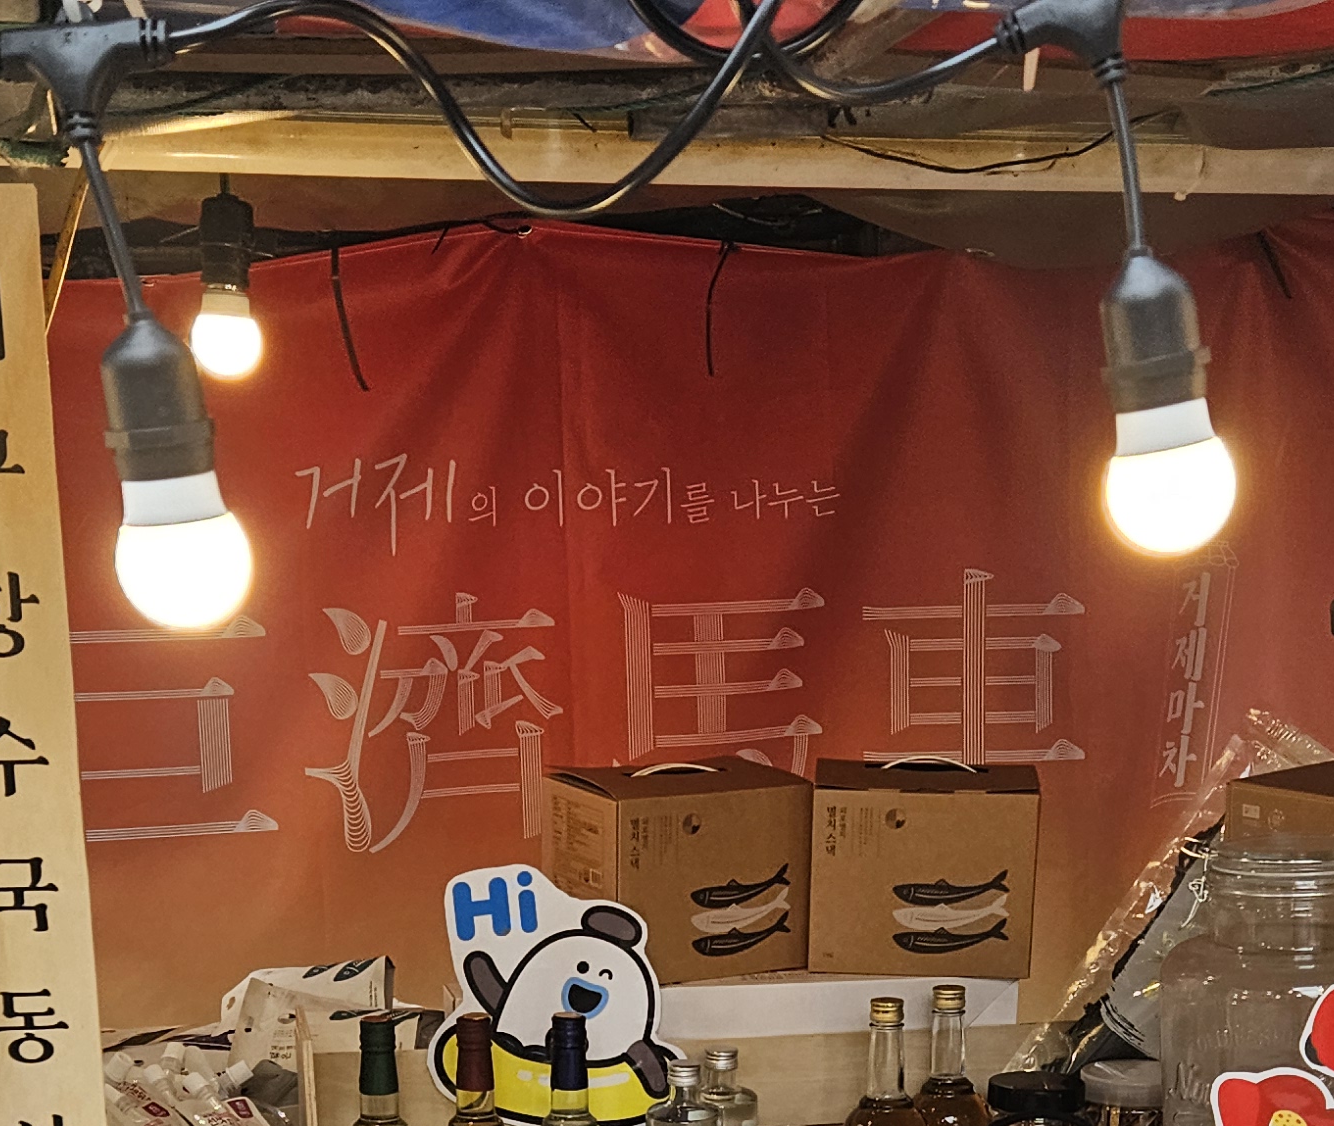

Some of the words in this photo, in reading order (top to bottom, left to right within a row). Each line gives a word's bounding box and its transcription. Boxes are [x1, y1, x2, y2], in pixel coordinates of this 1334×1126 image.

[294, 452, 499, 557] 거제의
[523, 466, 716, 528] 이야기를
[729, 478, 842, 519] 나누는
[1157, 571, 1212, 789] 거제마차
[452, 870, 539, 942] Hi
